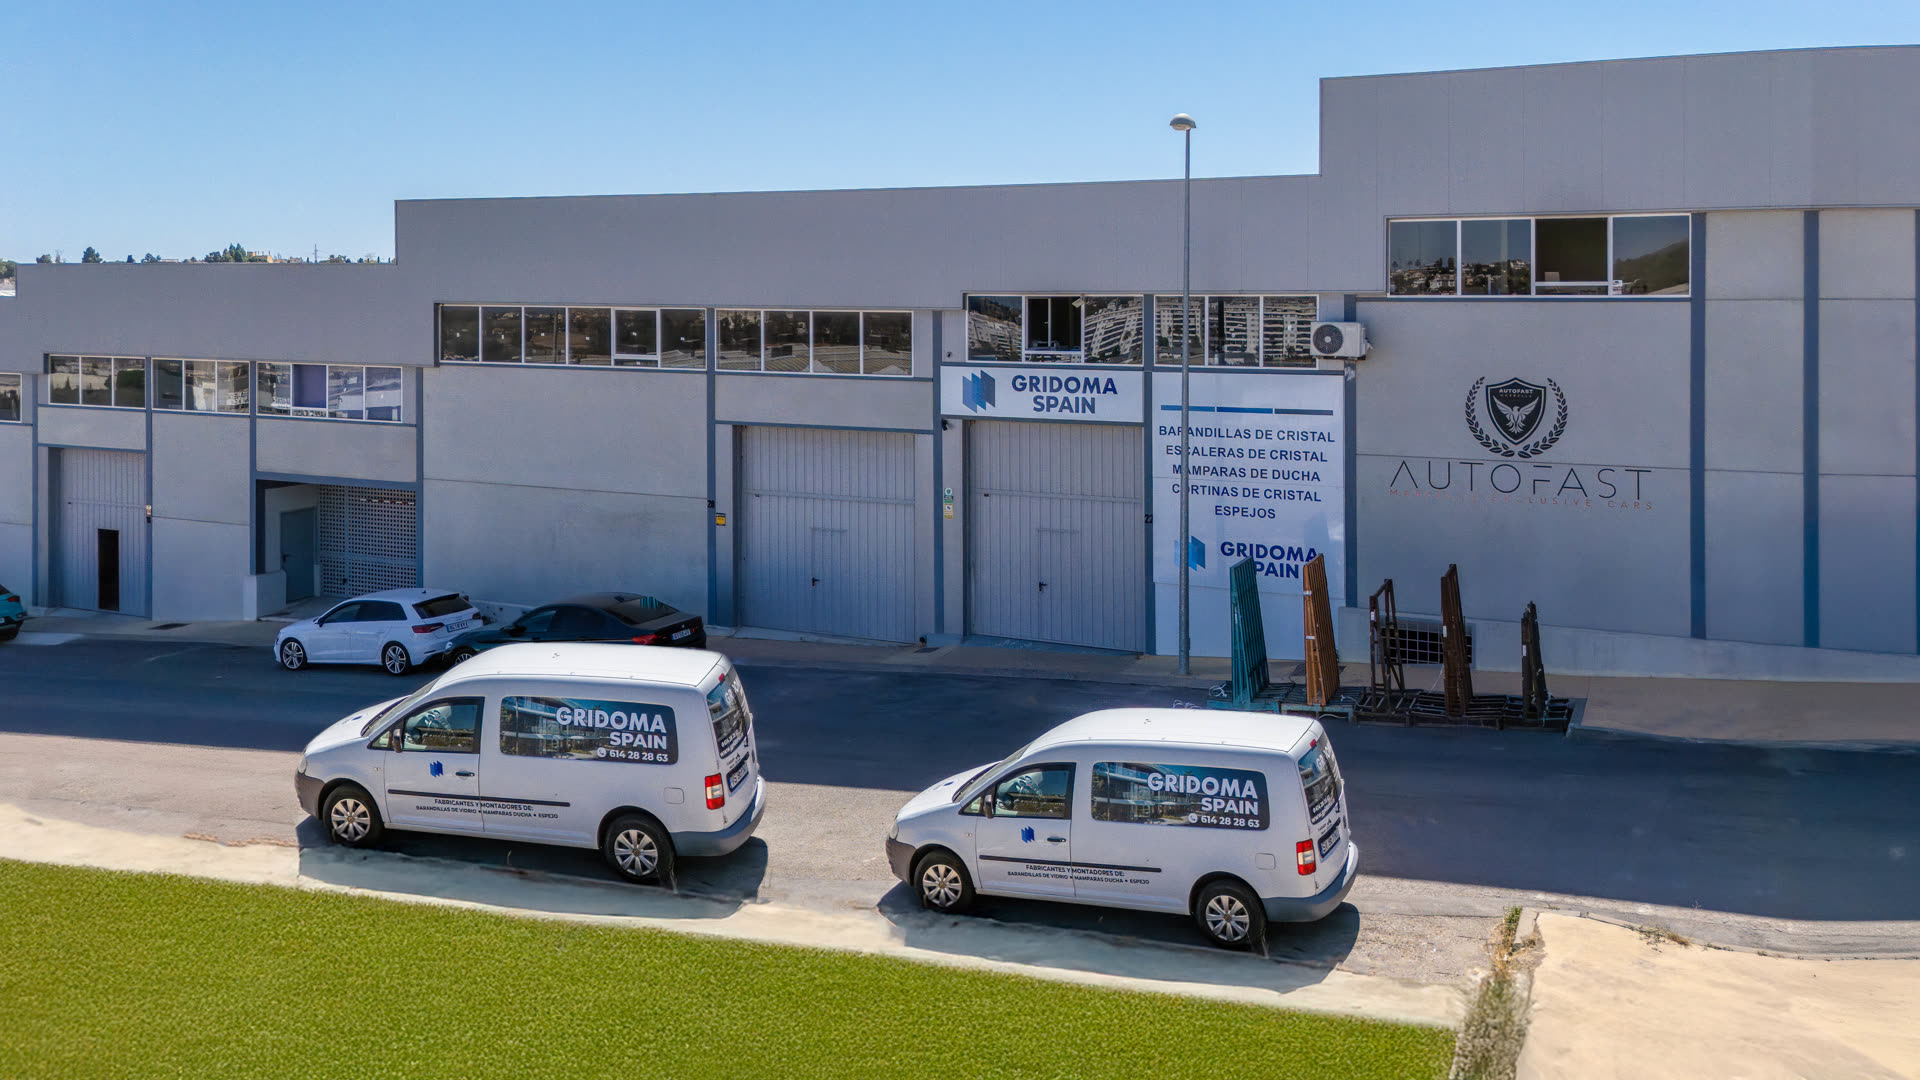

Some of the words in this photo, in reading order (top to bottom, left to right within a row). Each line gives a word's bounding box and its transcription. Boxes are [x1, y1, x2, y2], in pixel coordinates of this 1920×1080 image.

[1011, 374, 1118, 395] GRIDOMA
[1032, 395, 1096, 414] SPAIN
[1255, 429, 1273, 440] DE
[1276, 430, 1335, 443] CRISTAL
[1248, 448, 1266, 459] DE
[1269, 449, 1328, 462] CRISTAL
[1250, 468, 1268, 479] DE
[1272, 469, 1321, 482] DUCHA
[1390, 460, 1652, 500] AUTOFAST
[1172, 483, 1239, 497] CRTINAS
[1242, 487, 1260, 498] DE
[1263, 488, 1322, 502] CRISTAL
[1214, 505, 1276, 519] ESPEJOS
[1607, 500, 1653, 510] CARS
[1220, 541, 1318, 563] GRIDOMA
[1254, 561, 1299, 579] PAIN
[555, 706, 667, 733] GRIDOMA
[609, 731, 667, 750] SPAIN
[609, 749, 626, 759] 614
[627, 751, 640, 760] 28
[641, 752, 654, 761] 28
[656, 753, 669, 762] 63
[1147, 772, 1259, 799] GRIDOMA
[434, 799, 474, 807] FABRICANTES
[480, 802, 522, 811] MONTADORES
[1201, 797, 1259, 816] SPAIN
[483, 809, 512, 817] MAMPARAS
[1200, 815, 1217, 824] 614
[1219, 816, 1232, 826] 28
[1233, 818, 1246, 827] 28
[1247, 819, 1260, 828] 63
[1025, 864, 1066, 873] FABRICANTES
[1071, 868, 1114, 877] MONTADORES
[1074, 875, 1104, 883] MAMPARAS
